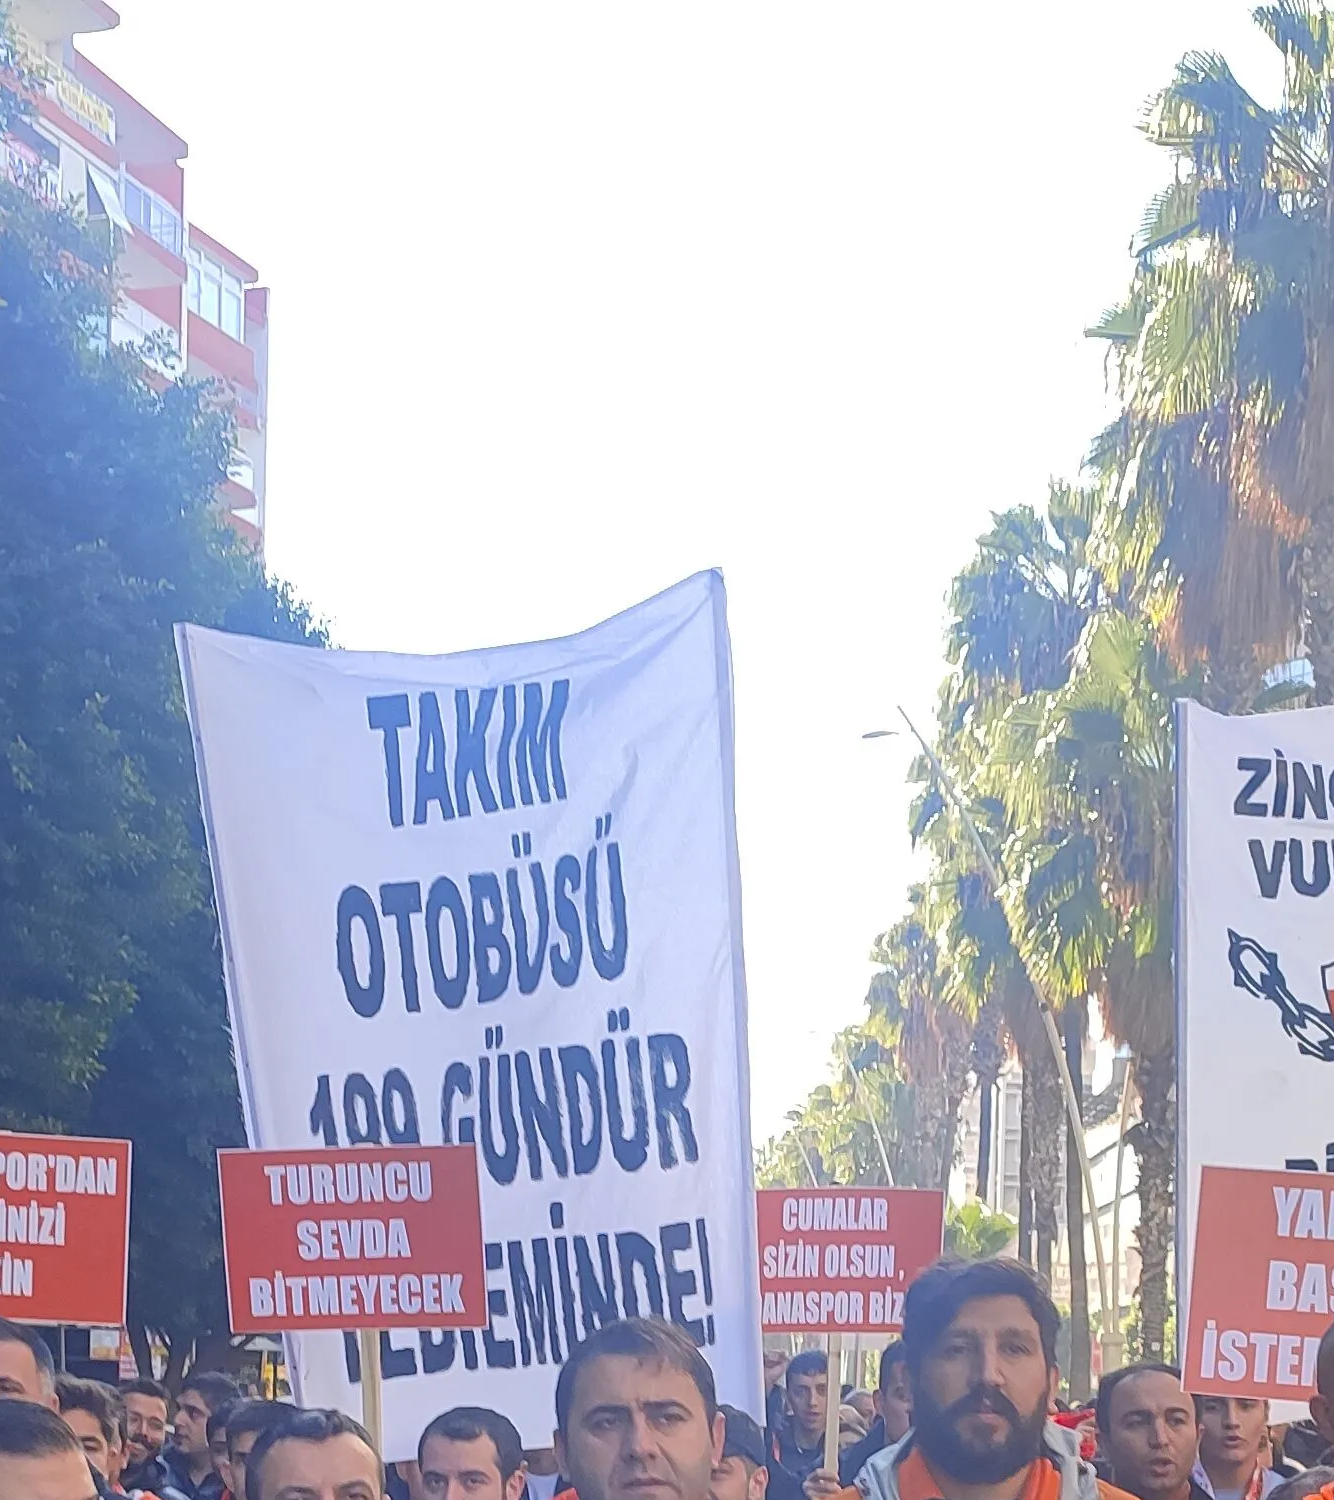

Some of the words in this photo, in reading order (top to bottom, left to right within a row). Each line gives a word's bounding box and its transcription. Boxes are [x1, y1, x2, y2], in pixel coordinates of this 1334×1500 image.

[366, 679, 570, 829] TAKIM
[336, 813, 628, 1018] OTOBÜSÜ
[441, 1007, 700, 1186] GÜNDÜR
[264, 1161, 432, 1206] TURUNCU
[782, 1197, 888, 1232] CUMALAR
[296, 1218, 411, 1260] SEVDA
[763, 1238, 819, 1279] SİZİN
[249, 1270, 466, 1318] BİTMEYECEK
